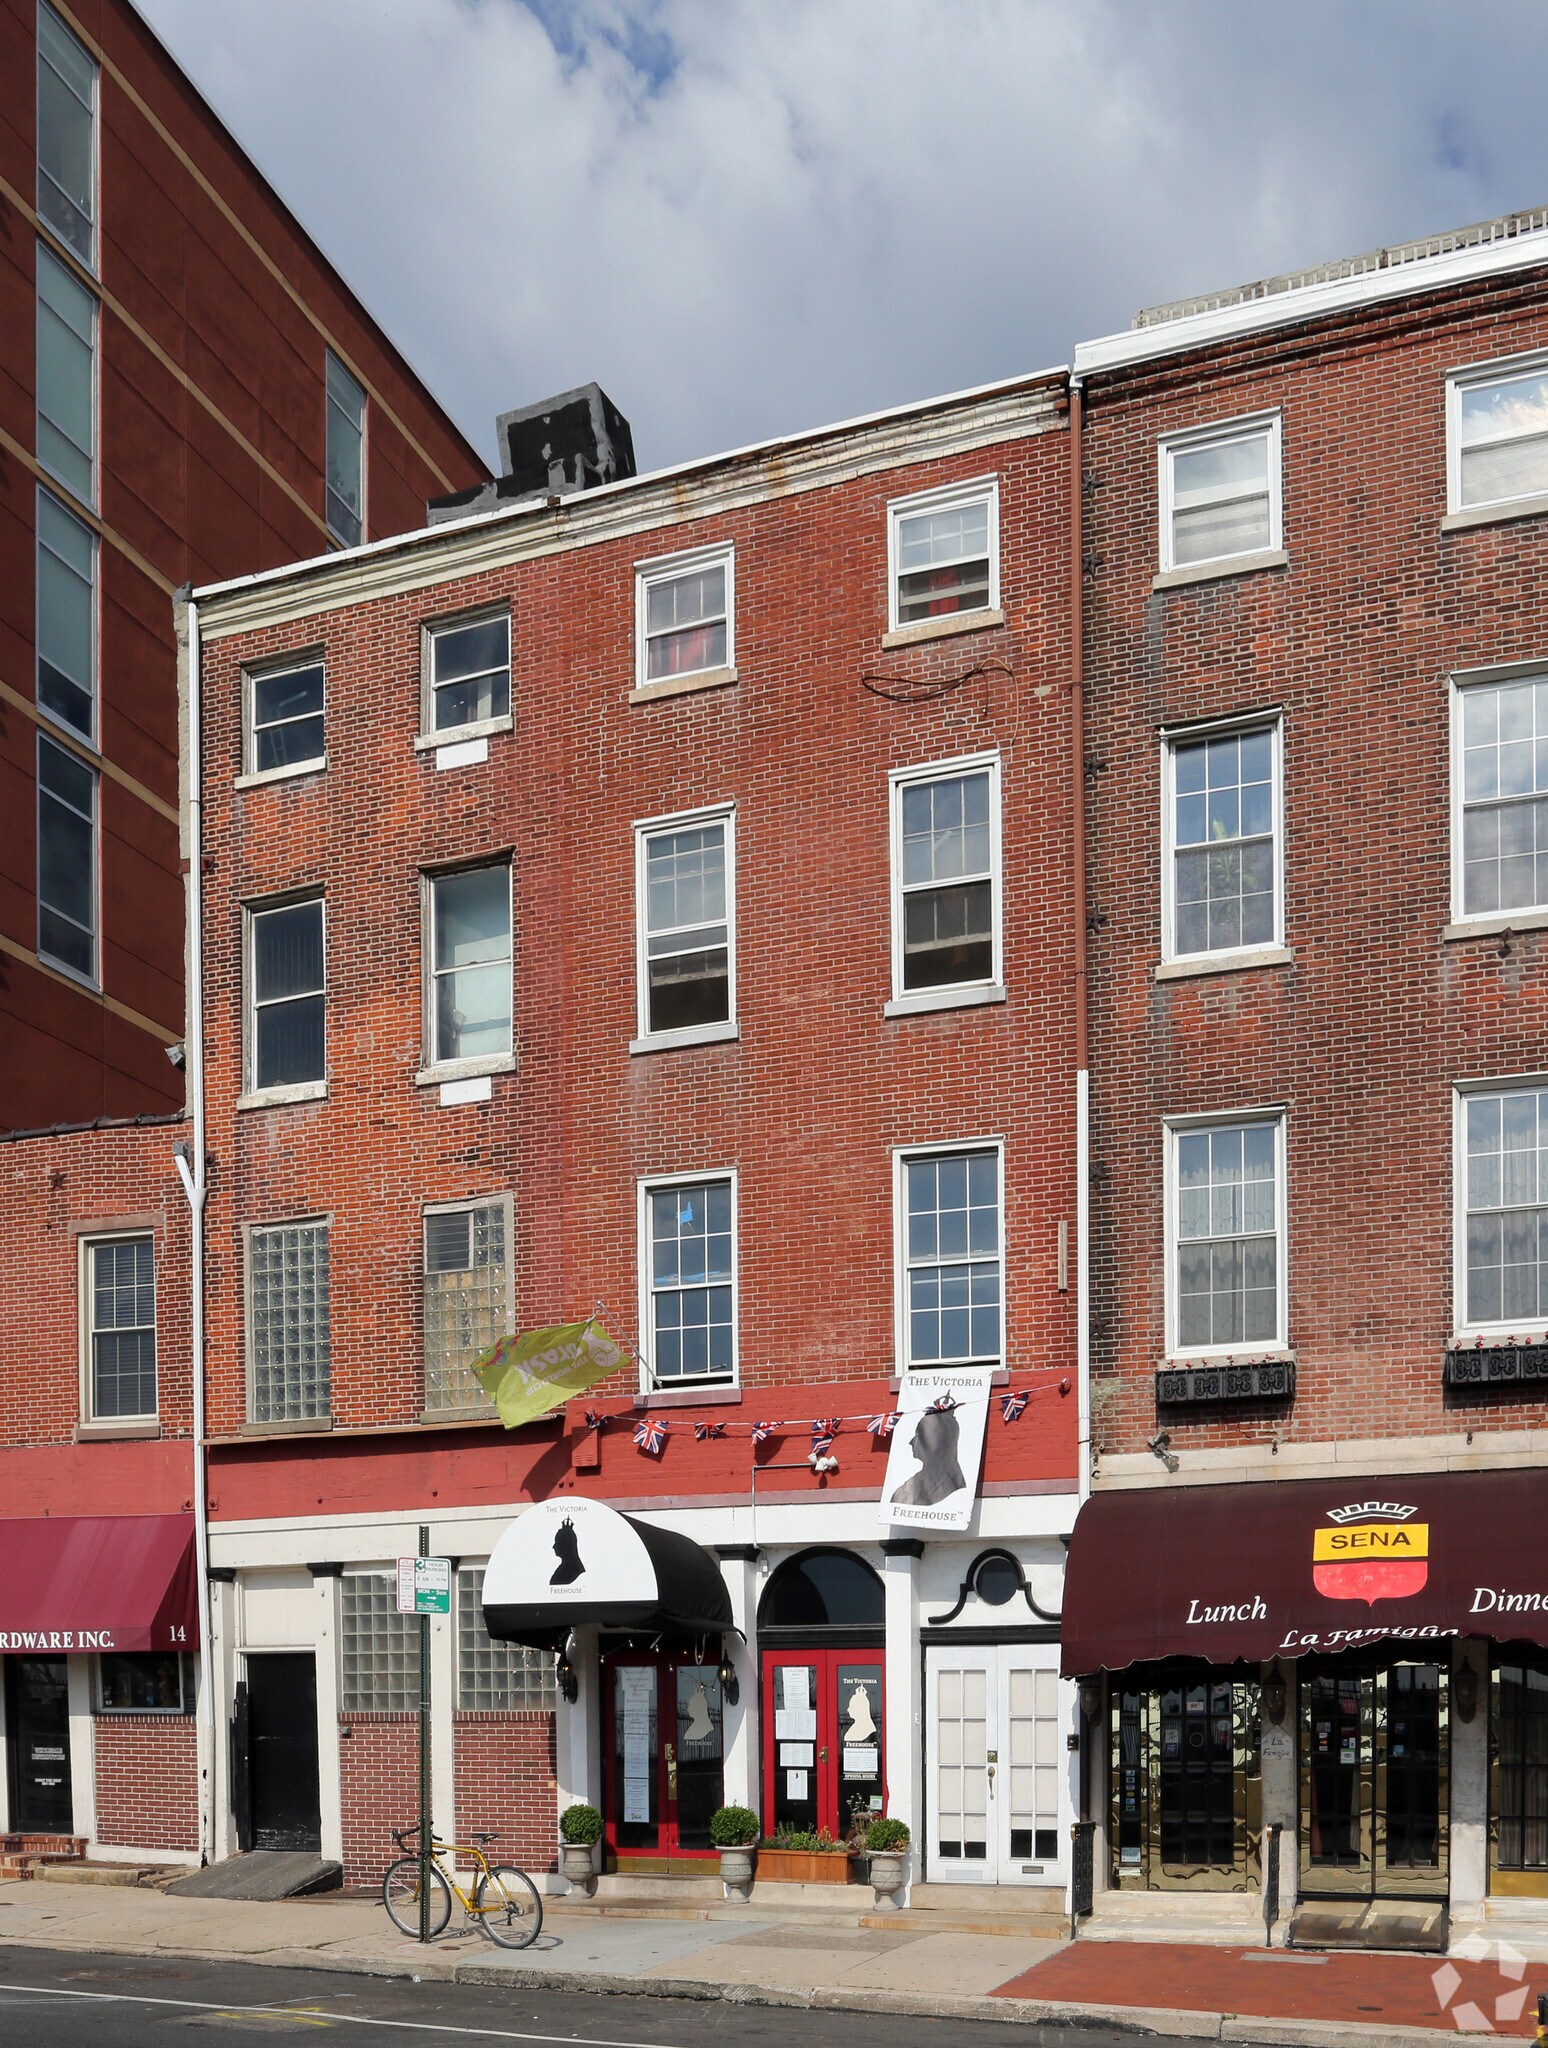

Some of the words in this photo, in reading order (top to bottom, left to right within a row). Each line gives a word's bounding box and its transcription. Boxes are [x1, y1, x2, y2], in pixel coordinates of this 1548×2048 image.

[526, 1381, 542, 1396] CUP
[908, 1376, 930, 1387] THE
[932, 1376, 983, 1387] VICTORIA
[545, 1505, 557, 1513] THE
[558, 1505, 588, 1513] VICTORIA
[1330, 1531, 1412, 1550] SENA
[415, 1559, 426, 1573] 3
[1468, 1587, 1548, 1613] Dinne
[1185, 1596, 1268, 1625] Lunch
[0, 1631, 74, 1649] RDWARE
[77, 1630, 116, 1649] INC.
[169, 1625, 187, 1642] 14
[1279, 1629, 1320, 1648] La
